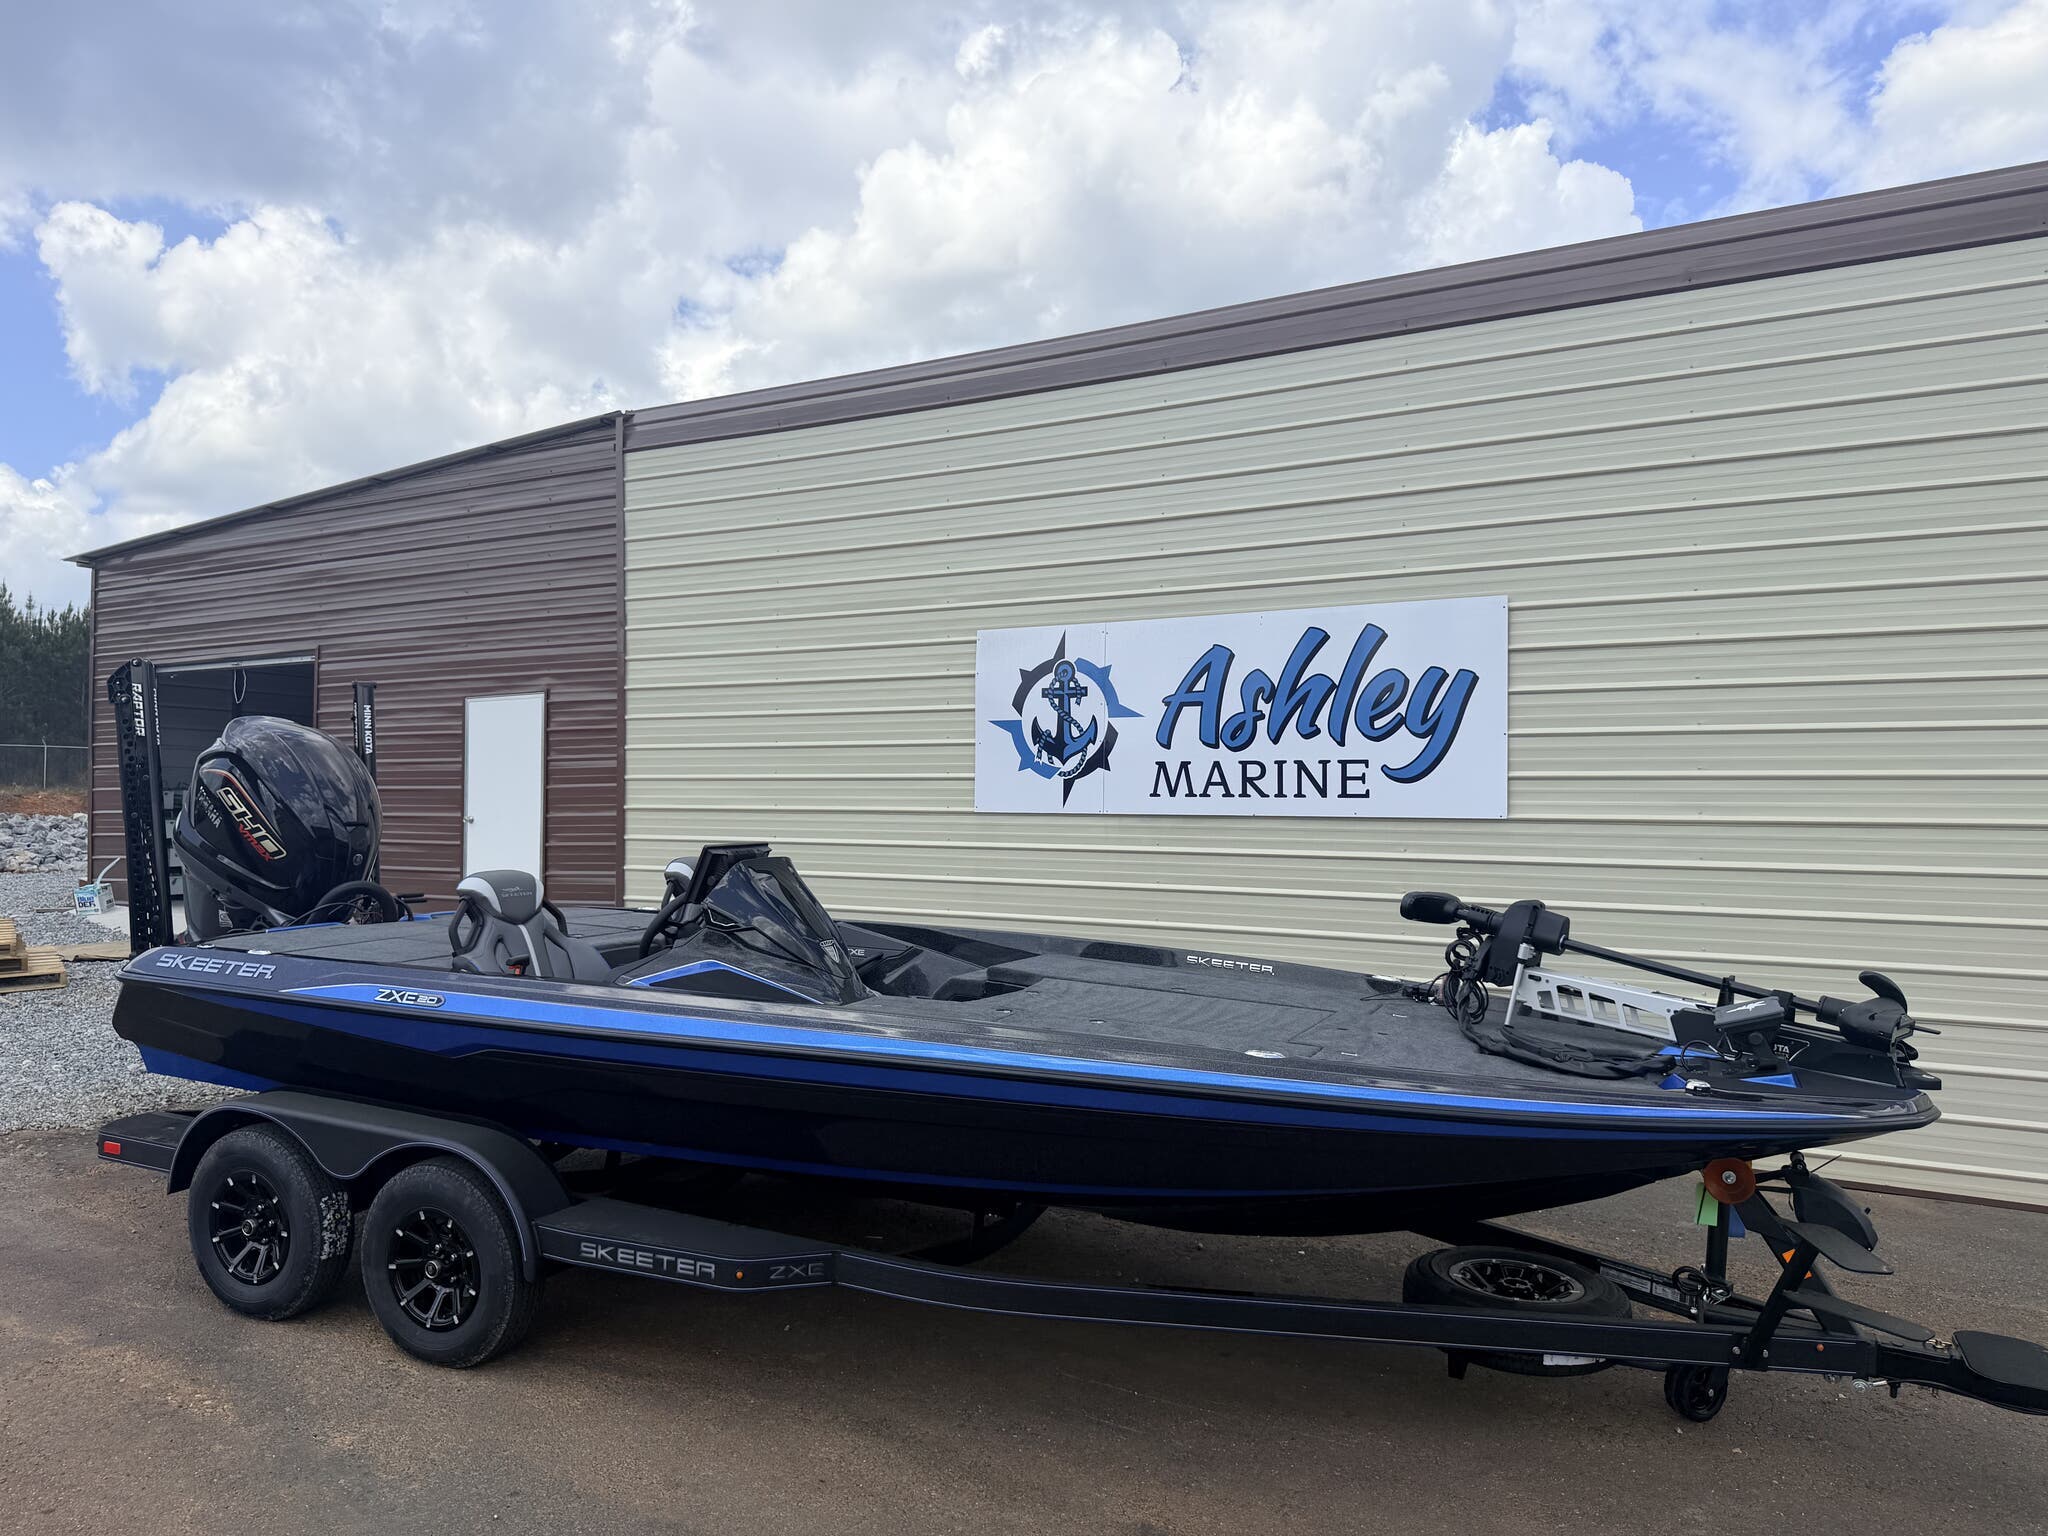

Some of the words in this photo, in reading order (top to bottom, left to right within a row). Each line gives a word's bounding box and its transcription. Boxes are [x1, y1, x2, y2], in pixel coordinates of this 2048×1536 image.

[131, 682, 146, 737] RAPTOR
[363, 704, 372, 729] MINN
[1154, 622, 1480, 784] Ashley
[364, 730, 373, 755] KOTA
[1149, 759, 1370, 799] MARINE
[216, 786, 287, 860] SHO
[156, 952, 277, 979] SKEETER
[847, 948, 865, 956] XE
[1186, 955, 1274, 975] SKEETER
[580, 1242, 716, 1279] SKEETER
[769, 1262, 825, 1279] ZXE
